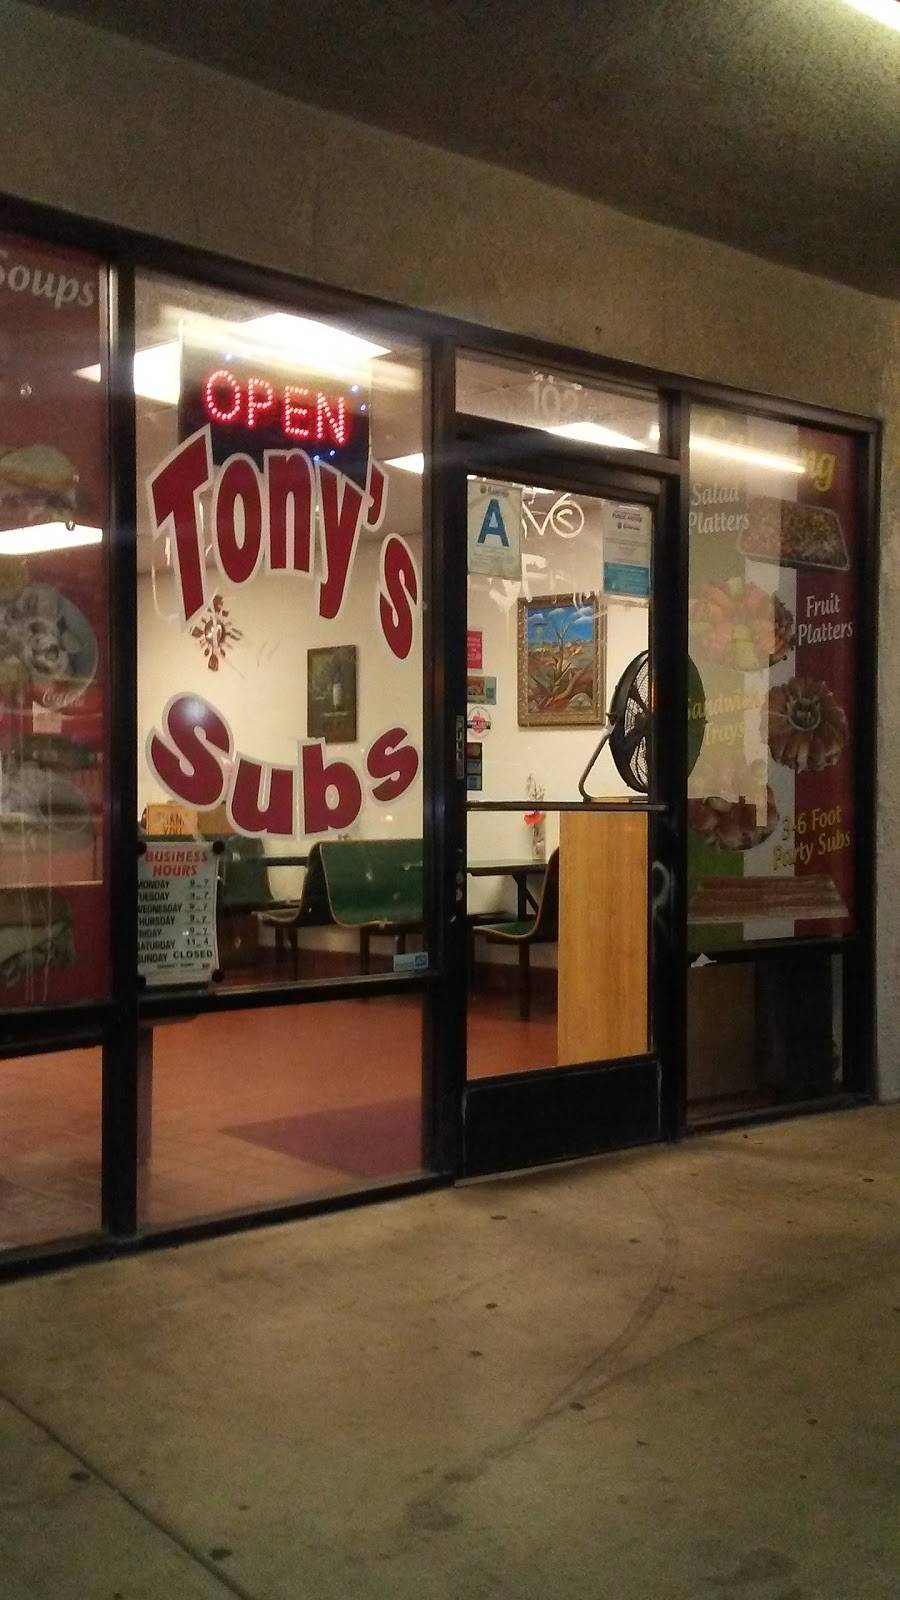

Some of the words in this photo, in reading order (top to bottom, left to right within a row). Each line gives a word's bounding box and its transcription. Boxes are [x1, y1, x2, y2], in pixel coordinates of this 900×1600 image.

[206, 369, 346, 444] OPEN
[691, 482, 741, 506] Salad
[477, 498, 510, 547] A
[689, 511, 750, 536] Platters
[148, 426, 420, 661] Tony's
[806, 592, 841, 618] Fruit
[798, 621, 853, 646] Platters
[148, 693, 420, 837] Subs
[811, 805, 843, 830] Foot
[818, 829, 851, 855] Subs
[144, 849, 209, 864] BUSINESS
[152, 864, 199, 878] HOURS
[138, 916, 176, 926] HURSDAY
[172, 950, 213, 960] CLOSED
